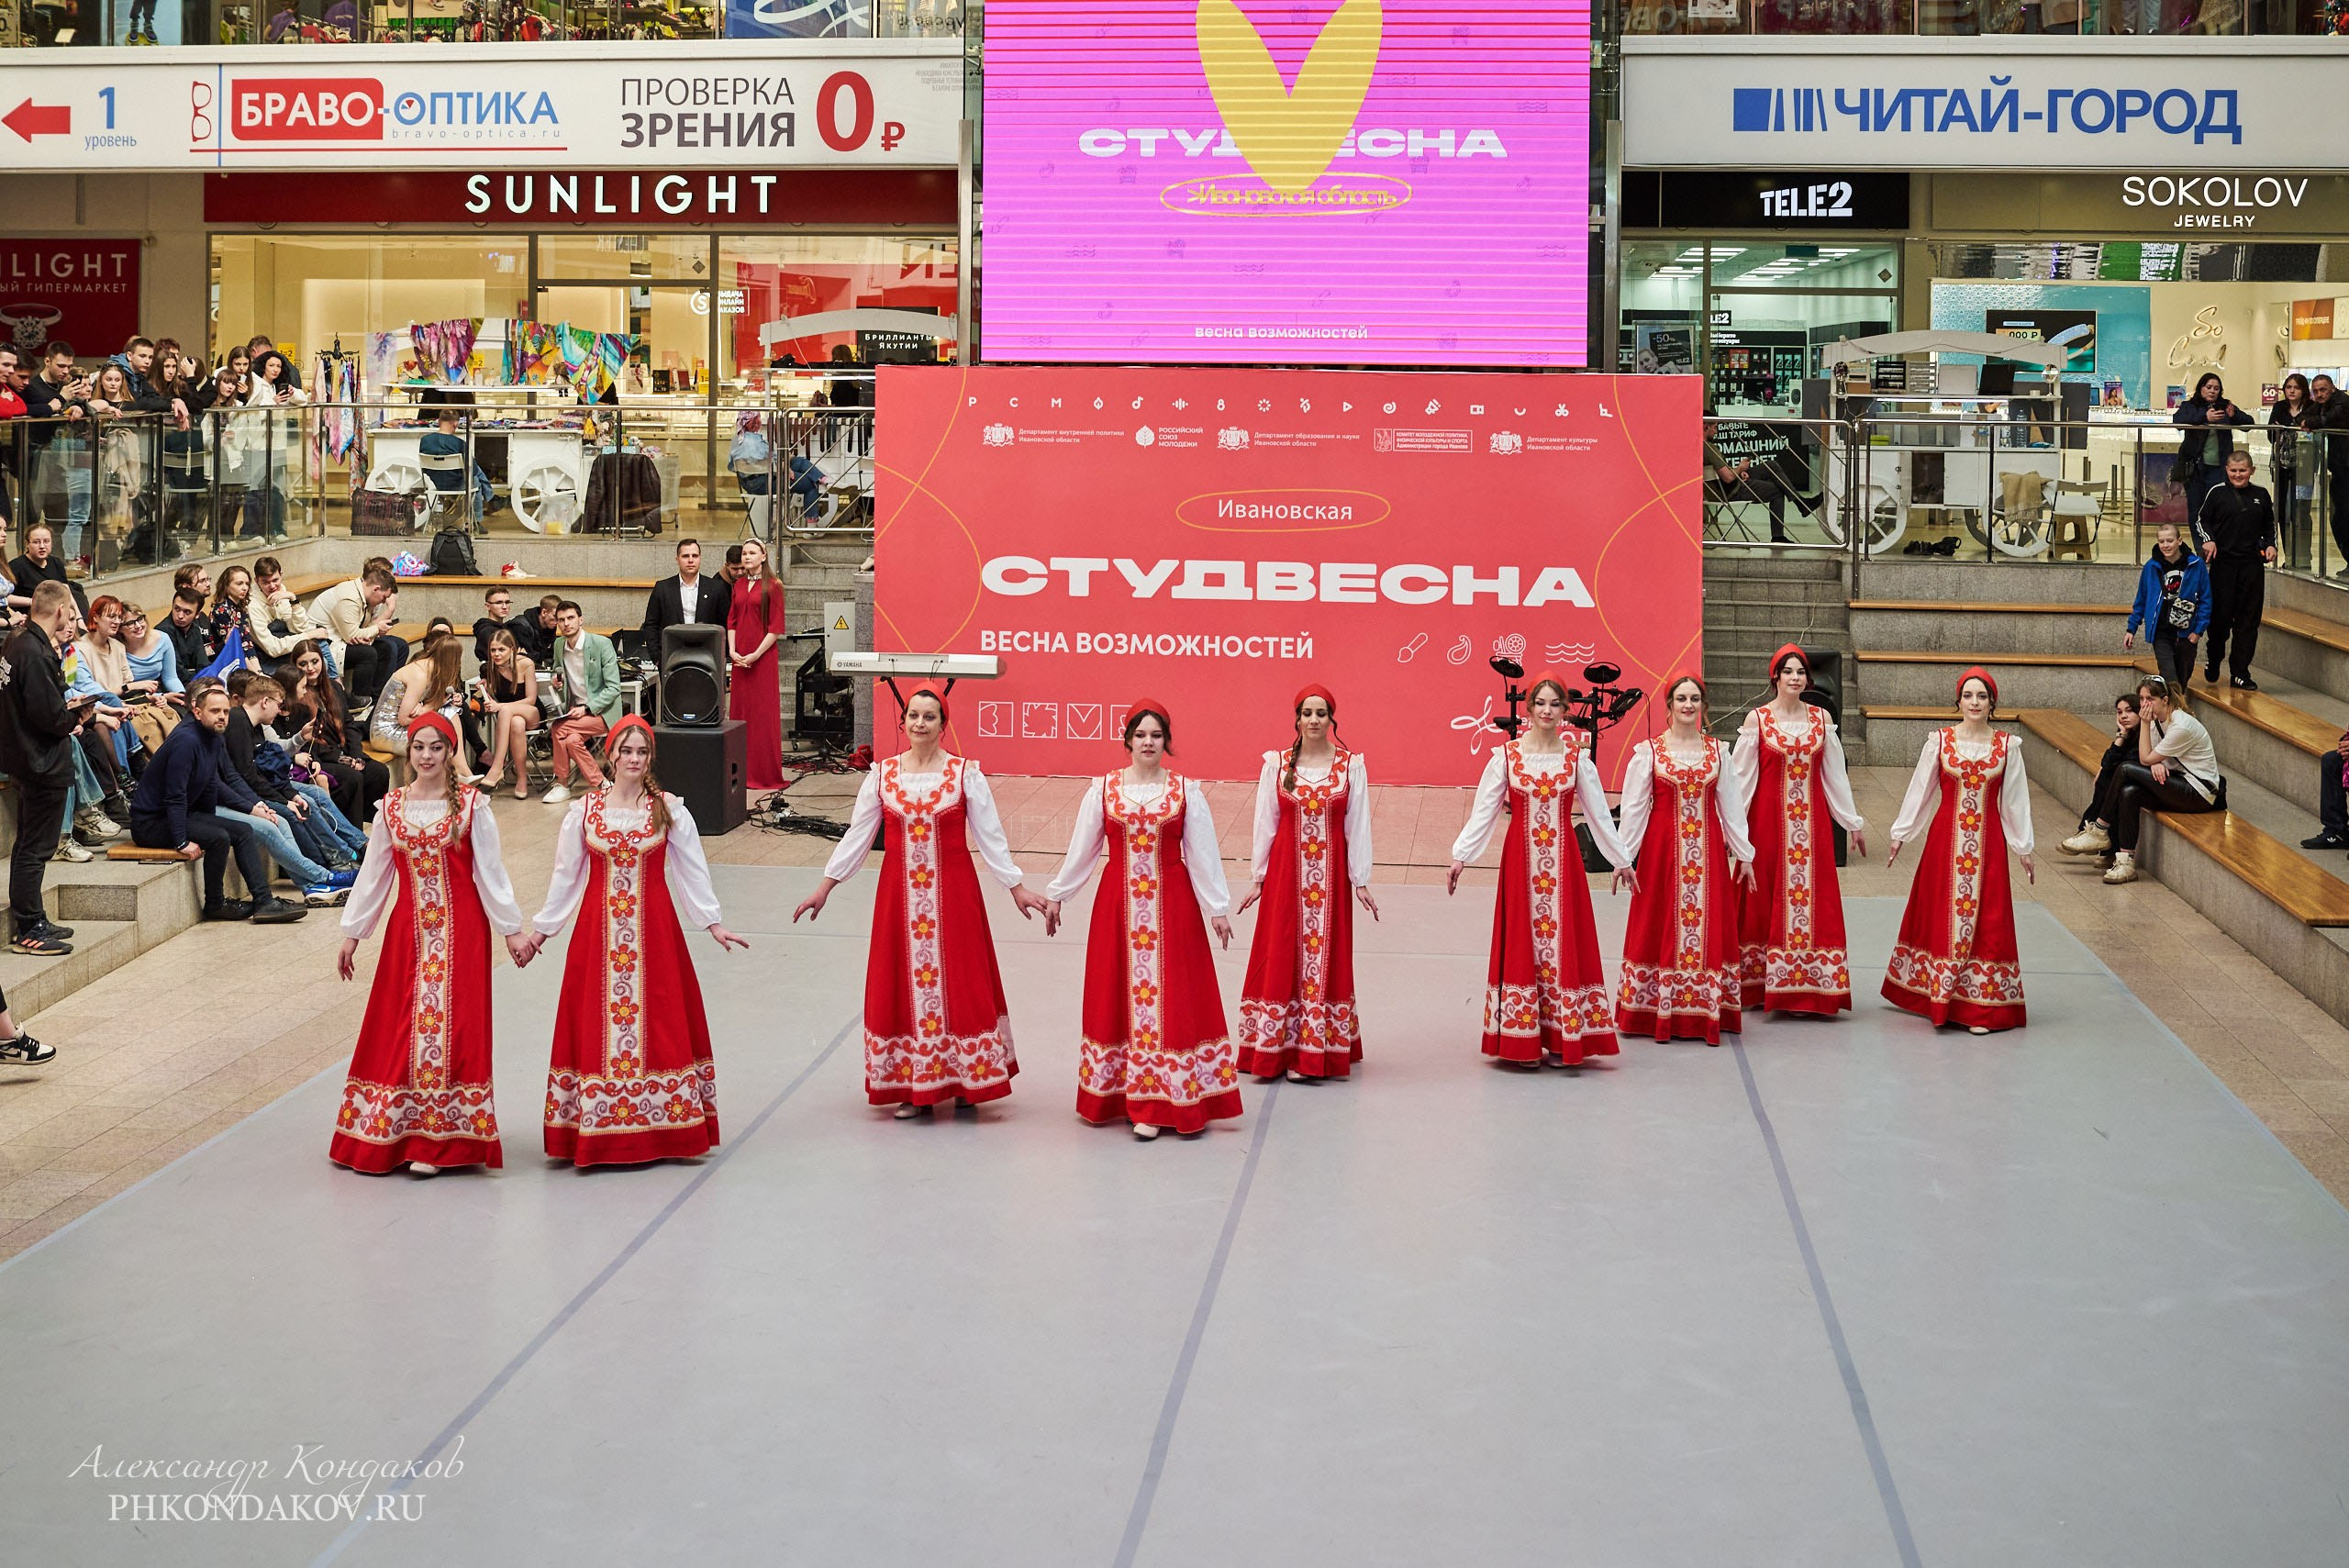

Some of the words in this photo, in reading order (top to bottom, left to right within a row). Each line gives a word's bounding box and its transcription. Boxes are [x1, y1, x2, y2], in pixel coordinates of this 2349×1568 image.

[621, 77, 795, 106] ПРОВЕРКА
[98, 87, 116, 129] 1
[240, 91, 559, 127] БРАВО-ОПТИКА
[1834, 75, 2242, 145] ЧИТАЙ-ГОРОД
[84, 134, 137, 150] уровень
[392, 128, 561, 140] bravo-optica.ru
[620, 112, 796, 148] ЗРЕНИЯ
[465, 174, 777, 215] SUNLIGHT
[1759, 181, 1853, 217] TELE2
[2122, 176, 2309, 207] SOKOLOV
[2174, 215, 2255, 228] JEWELRY
[0, 252, 128, 278] LIGHT
[27, 283, 128, 294] ГИПЕРМАРКЕТ
[864, 333, 933, 341] БРИЛЛИАНТЫ
[1195, 328, 1243, 338] весна
[1248, 325, 1368, 339] возможностей
[2192, 306, 2224, 338] So
[2167, 336, 2227, 370] Cool
[1718, 422, 1750, 431] БАВЬТЕ
[1714, 435, 1790, 455] ОМАШНИЙ
[1217, 499, 1353, 521] Ивановская
[981, 555, 1596, 608] СТУДВЕСНА
[981, 629, 1070, 653] ВЕСНА
[1076, 630, 1313, 660] ВОЗМОЖНОСТЕЙ
